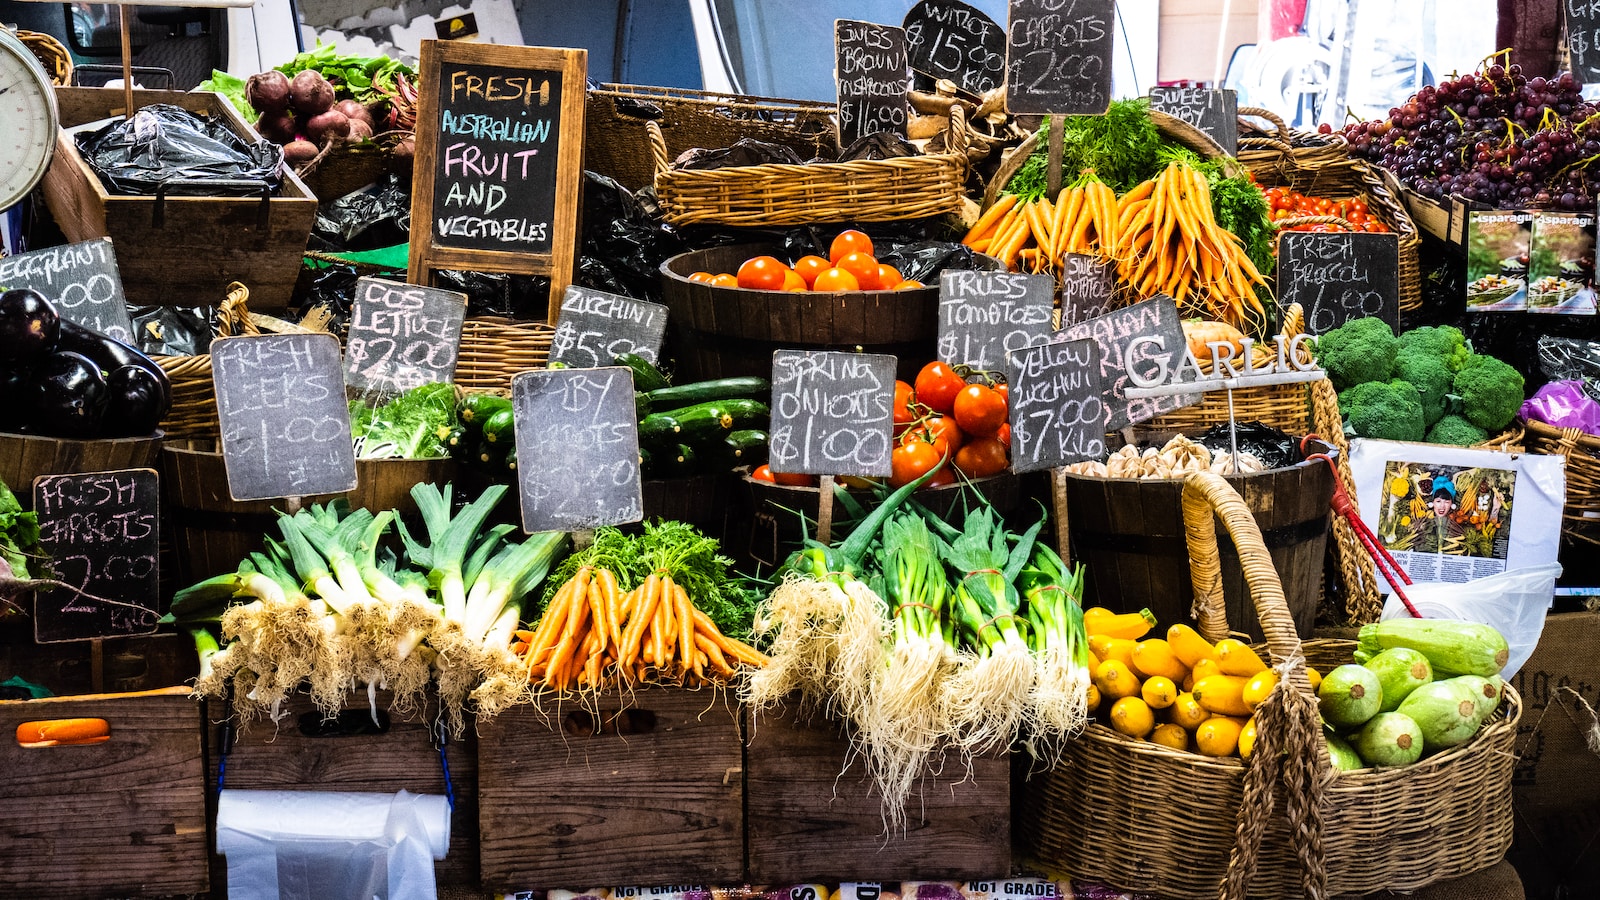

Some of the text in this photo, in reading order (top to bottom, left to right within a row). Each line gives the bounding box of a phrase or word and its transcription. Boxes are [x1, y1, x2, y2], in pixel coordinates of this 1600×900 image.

[841, 47, 898, 73] BROWN
[450, 70, 550, 106] FRESH
[1150, 88, 1213, 108] SWEET
[442, 110, 551, 143] AUSTRALIAN
[445, 142, 539, 182] FRUIT
[445, 181, 508, 215] AND
[0, 241, 106, 285] EGGPLANT
[1287, 235, 1353, 260] FRESH
[365, 284, 425, 309] COS
[942, 272, 1027, 299] TRUSS
[353, 304, 458, 341] LETTUCE
[1124, 333, 1319, 388] GARLIC
[779, 388, 892, 423] ONIONS
[1004, 883, 1054, 896] GRADE
